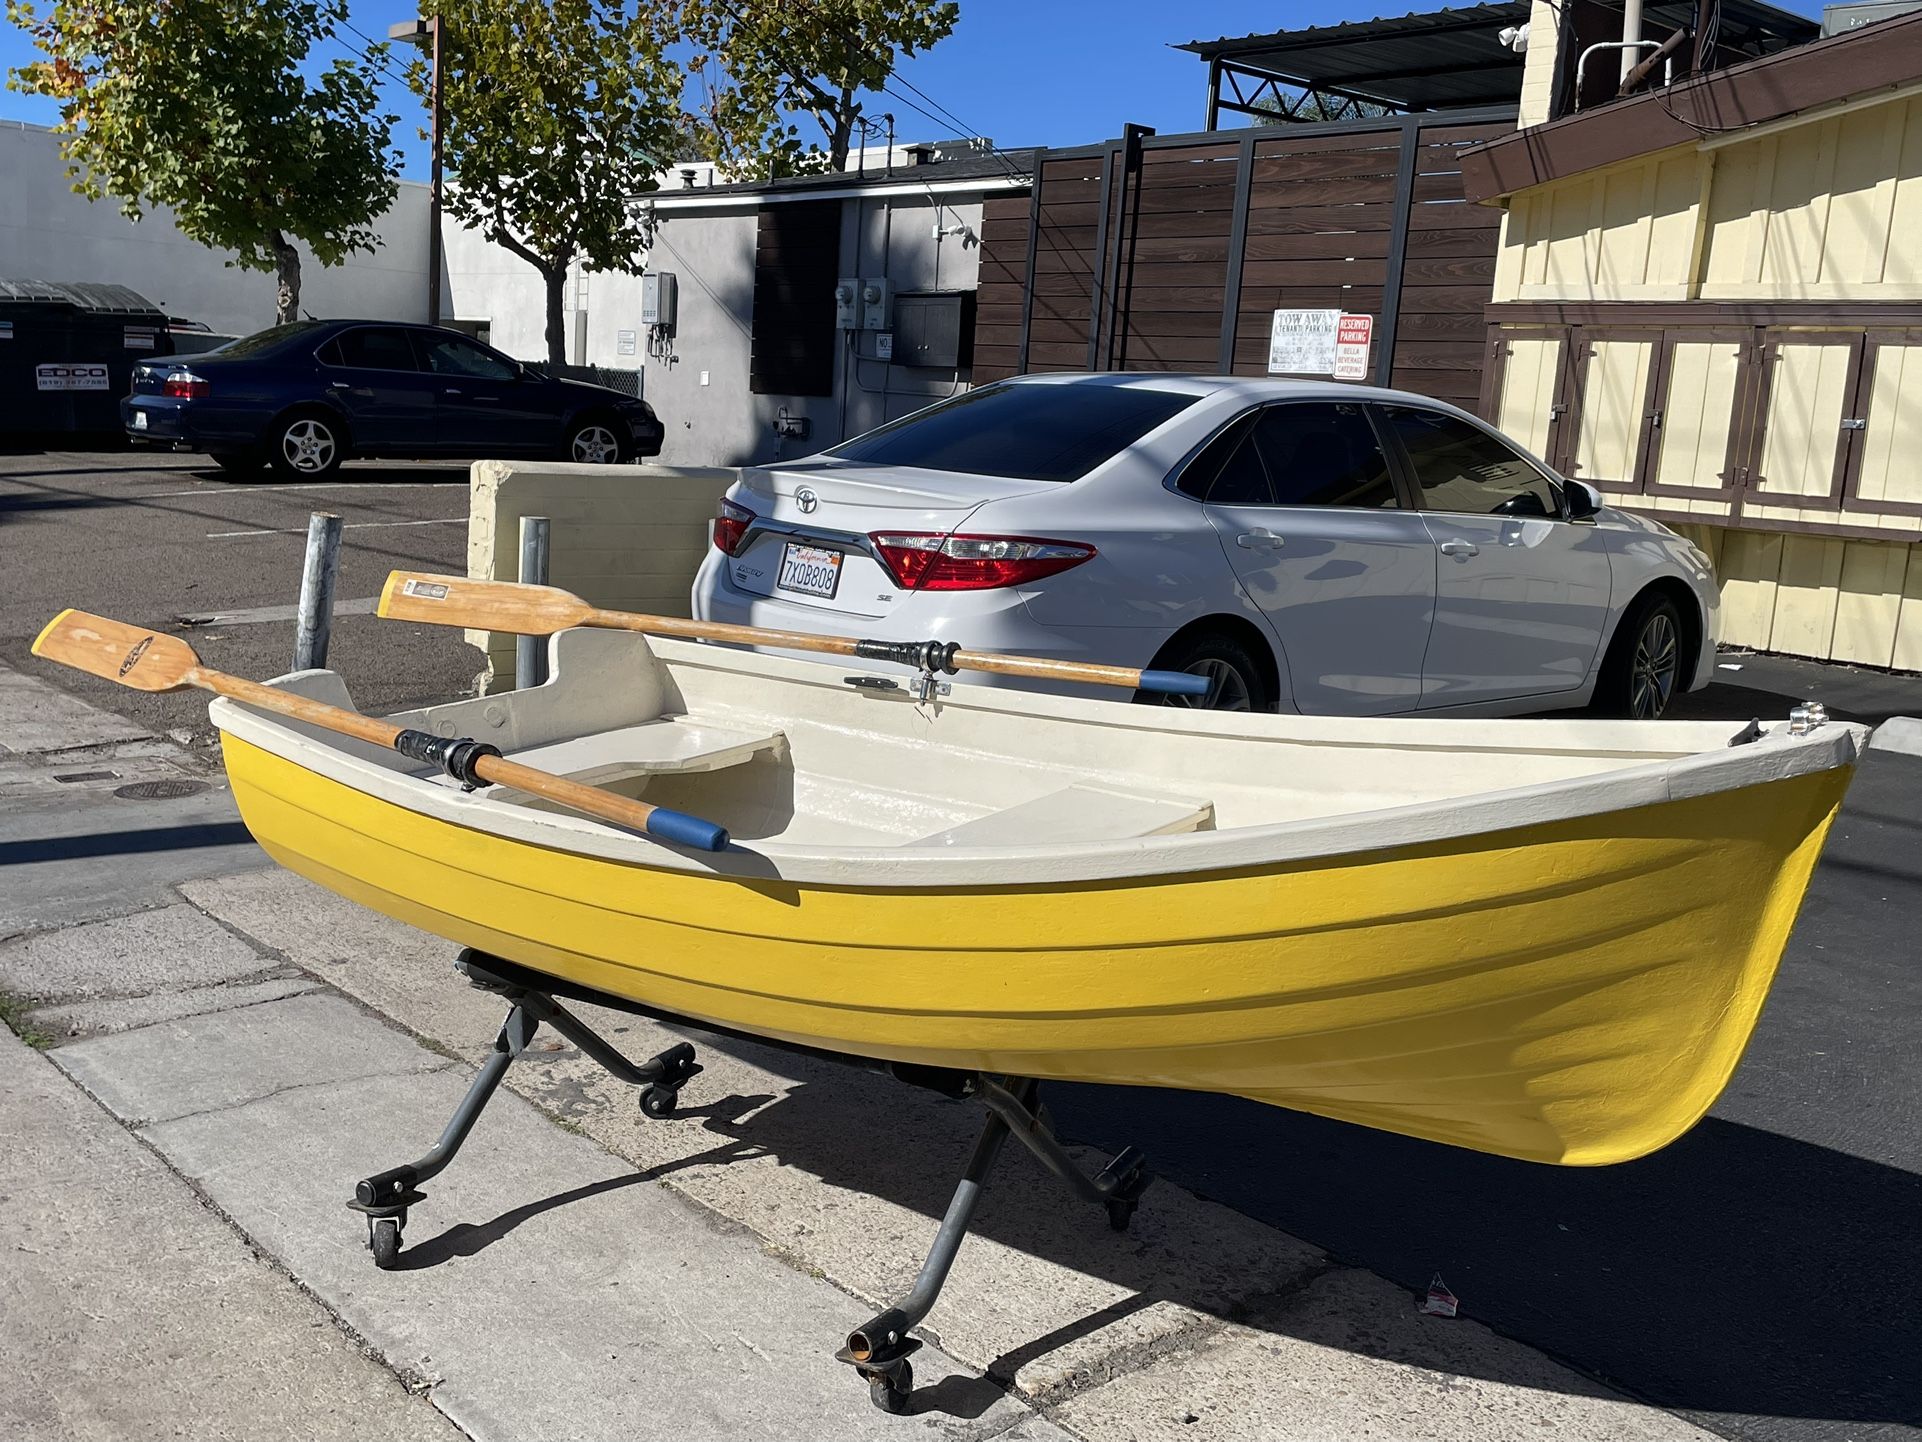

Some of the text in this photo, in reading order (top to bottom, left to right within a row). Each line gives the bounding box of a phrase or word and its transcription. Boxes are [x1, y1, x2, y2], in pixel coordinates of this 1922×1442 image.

[1279, 313, 1336, 325] TOW AWAY
[1340, 319, 1370, 330] RESERVED
[1340, 331, 1367, 342] PARKING
[1337, 356, 1364, 364] BEVERAGE
[38, 368, 106, 377] EDCO
[1337, 365, 1362, 373] CATERING
